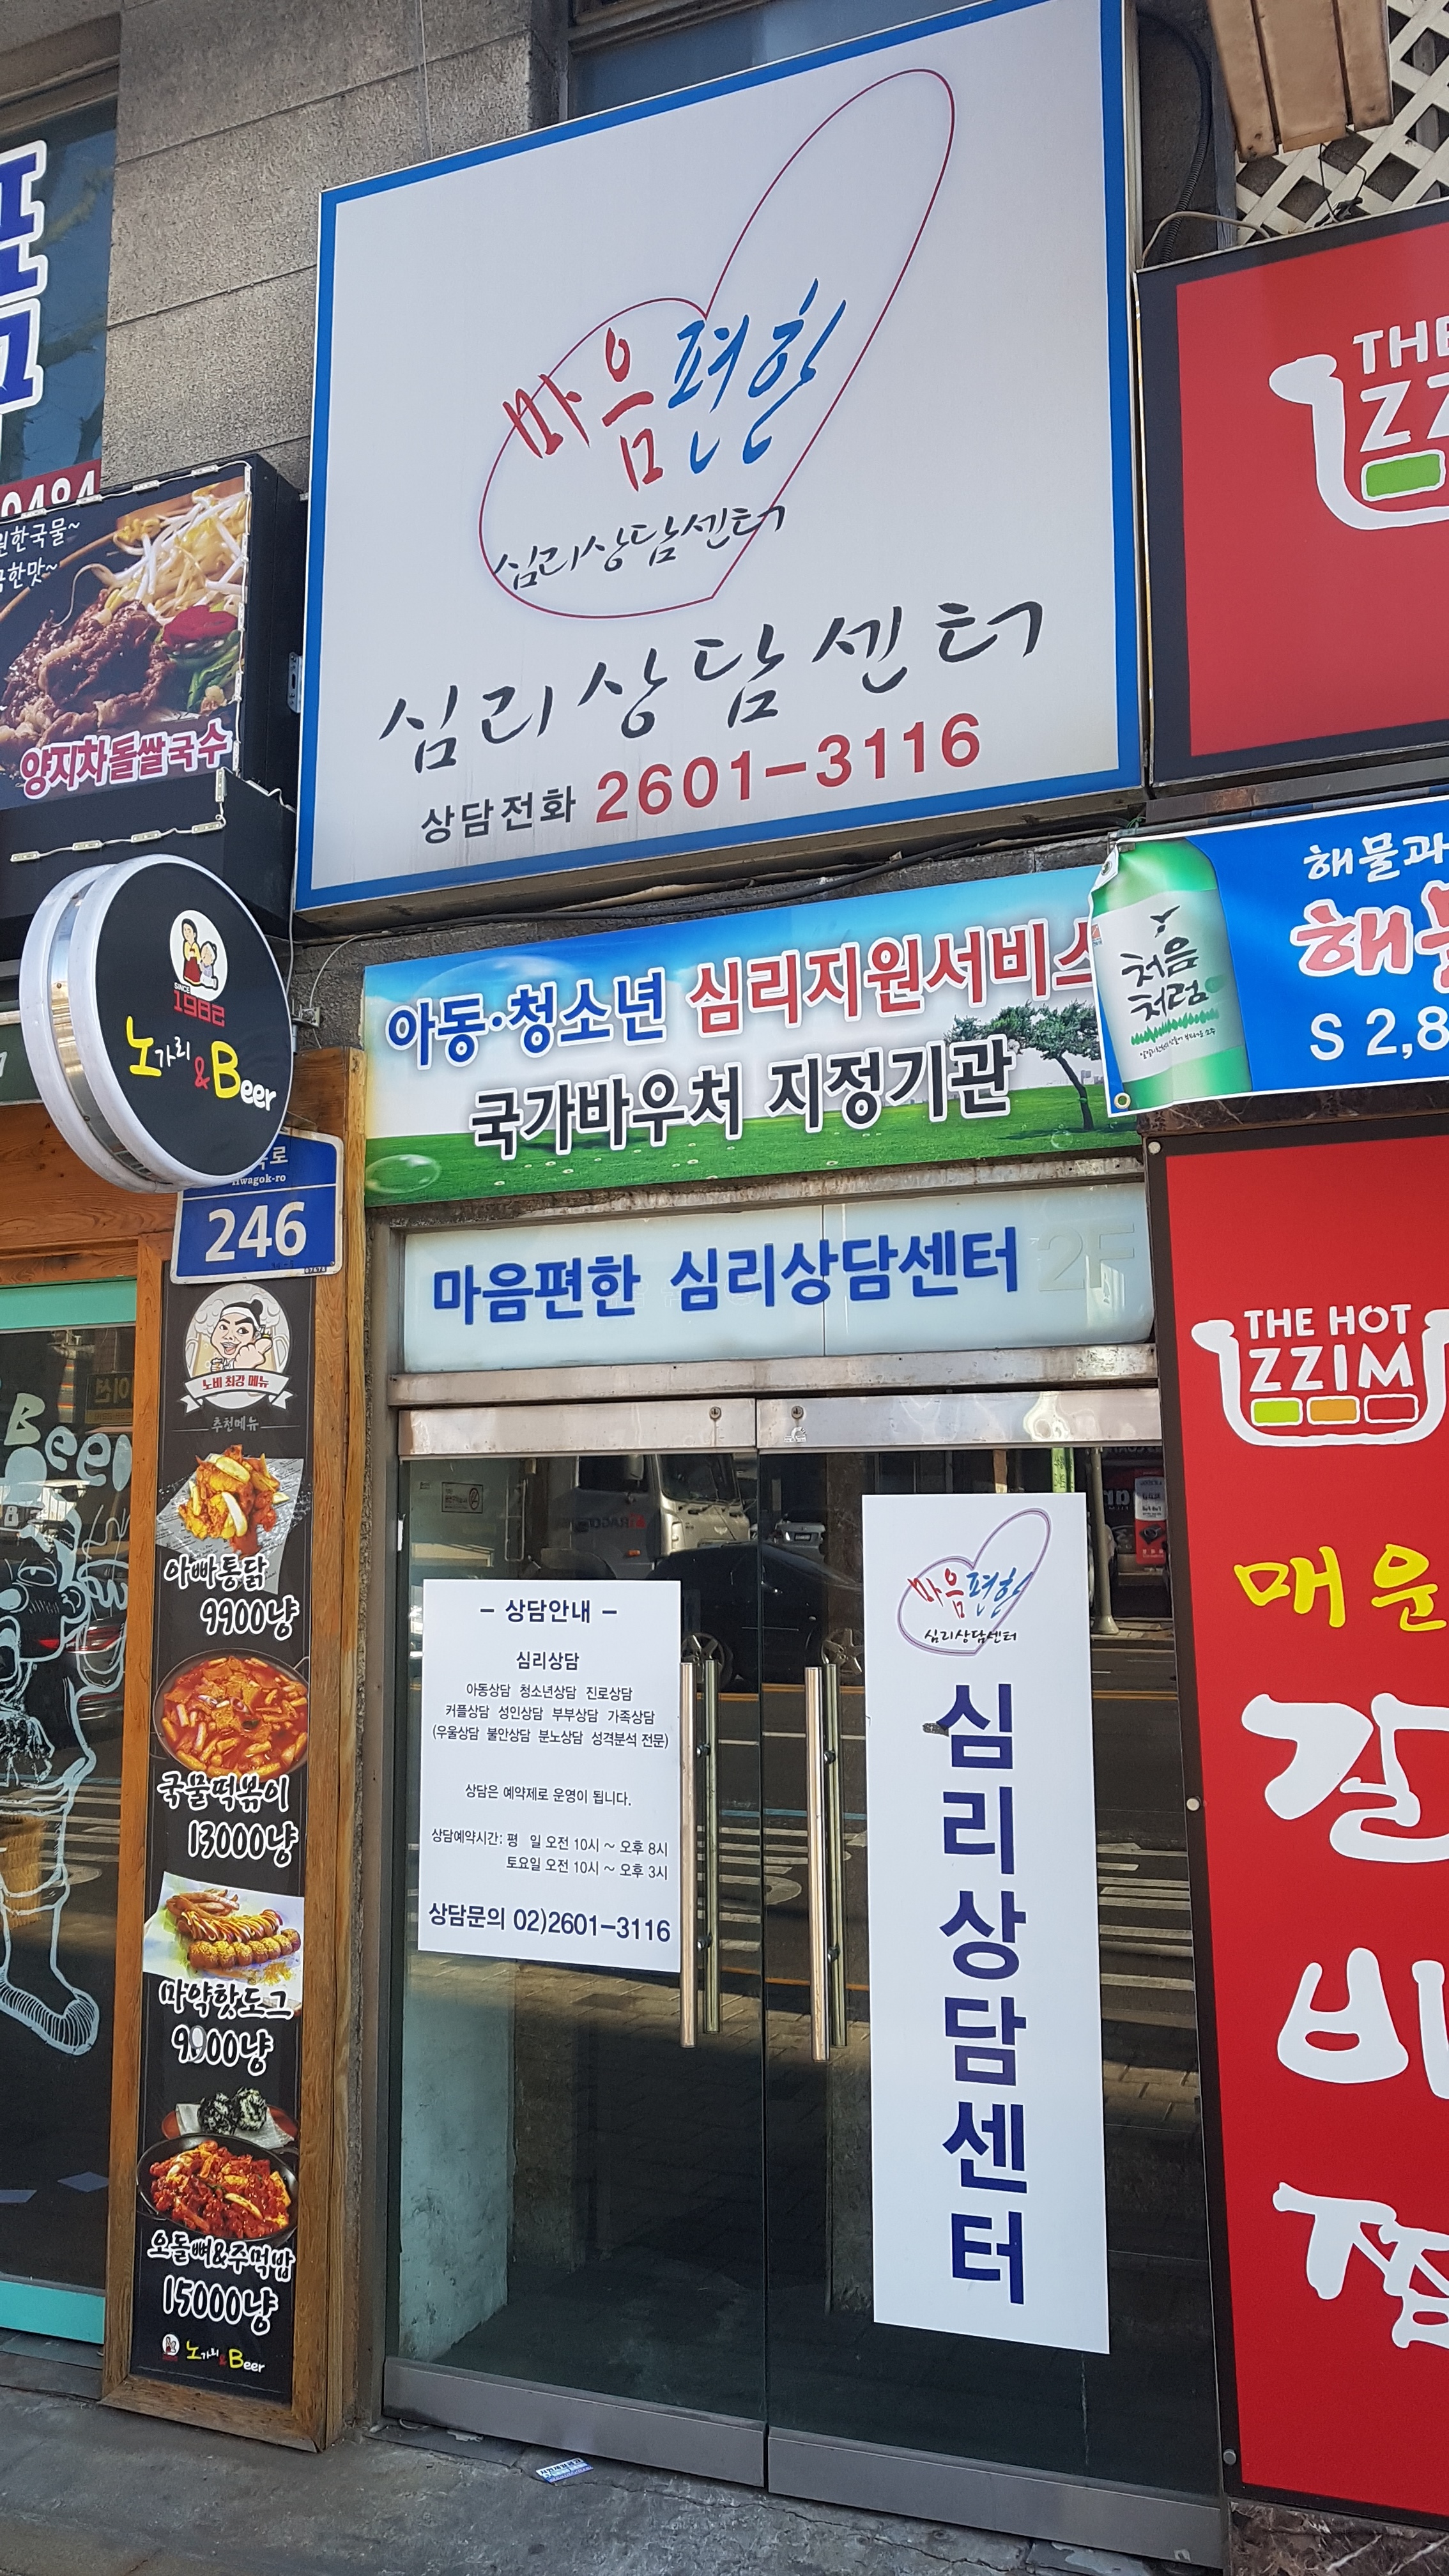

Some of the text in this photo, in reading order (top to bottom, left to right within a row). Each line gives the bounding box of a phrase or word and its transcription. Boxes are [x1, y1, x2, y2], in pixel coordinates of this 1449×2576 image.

[494, 505, 785, 590] 심리상담센터
[378, 600, 1045, 774] 심리상담센터
[20, 718, 233, 800] 양지차돌쌀국수
[422, 712, 981, 843] 상담전화 2601-3116
[1120, 936, 1199, 988] 처음
[173, 990, 226, 1027] 1982
[174, 982, 190, 993] SINCE
[1128, 979, 1209, 1022] 처럼
[386, 966, 666, 1070] 아동·청소년
[1310, 1013, 1344, 1061] S
[126, 1016, 277, 1112] 노가리 & Beer
[469, 1032, 1015, 1160] 국가바우처 지정기관
[204, 1201, 307, 1263] 246
[432, 1253, 642, 1326] 마음편한
[668, 1225, 1020, 1313] 심리상담센터
[1243, 1303, 1412, 1340] THE HOT
[202, 1375, 270, 1391] 노비 최강 메뉴
[1249, 1341, 1414, 1393] ZZIM
[211, 1415, 259, 1433] 추천메뉴
[163, 1553, 270, 1591] 아빠통닭
[1234, 1544, 1447, 1632] 매운
[200, 1595, 300, 1641] 9900냥
[505, 1599, 591, 1623] 상담안내
[924, 1629, 1017, 1644] 심리상담센터
[516, 1651, 579, 1670] 심리상담
[466, 1683, 632, 1701] 아동상담 청소년상담 진로상담
[445, 1705, 655, 1725] 커플상담 성인상담 부부상담 가족상담
[433, 1724, 669, 1749] (우울상담 불안상담 분노상담 성격분석 전문)
[157, 1770, 290, 1812] 국물떡볶이
[465, 1784, 631, 1806] 상담은 예약제로 운영이 됩니다.
[188, 1820, 299, 1867] 13000냥
[431, 1828, 503, 1846] 상담예약시간:
[546, 1836, 569, 1851] 오전
[574, 1837, 599, 1853] 10시
[620, 1840, 644, 1855] 오후
[648, 1841, 668, 1857] 8시
[506, 1856, 540, 1871] 토요일
[545, 1859, 569, 1873] 오전
[574, 1860, 599, 1876] 10시
[620, 1863, 644, 1878] 오후
[648, 1865, 668, 1880] 3시
[429, 1903, 671, 1942] 상담문의 02)2601-3116
[159, 1979, 294, 2020] 마약핫도그
[935, 1682, 1027, 2305] 심리상담센터
[148, 2230, 295, 2283] 오돌뼈&주먹밥
[162, 2275, 279, 2336] 15000냥
[229, 2349, 265, 2373] Beer
